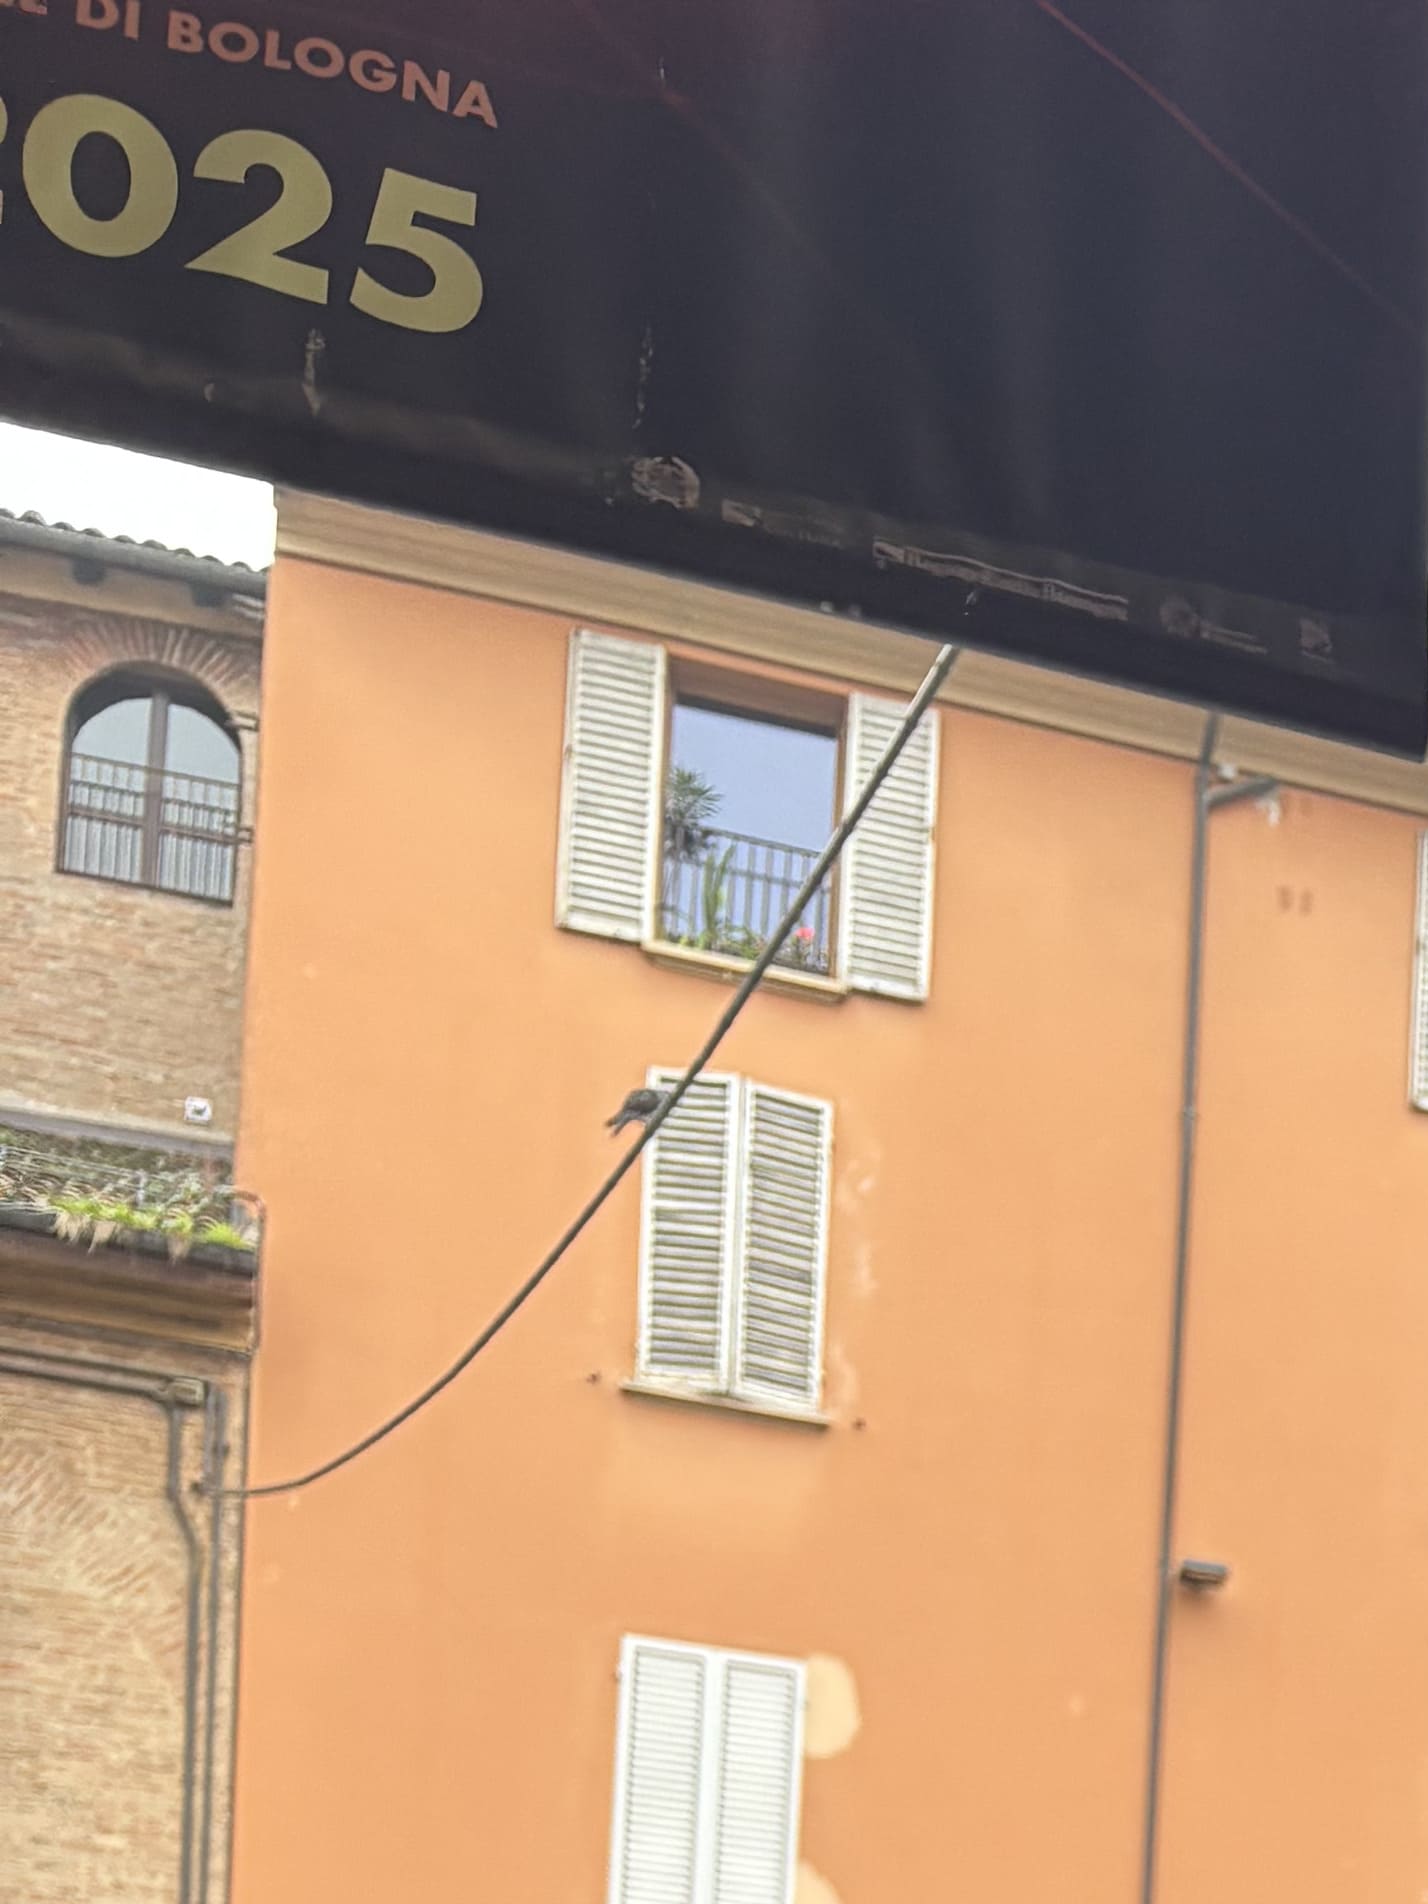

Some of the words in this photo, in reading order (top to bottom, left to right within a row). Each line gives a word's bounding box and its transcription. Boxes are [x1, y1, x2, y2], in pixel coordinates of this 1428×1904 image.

[74, 0, 141, 41] DI
[166, 9, 498, 129] BOLOGNA
[0, 93, 484, 333] 025
